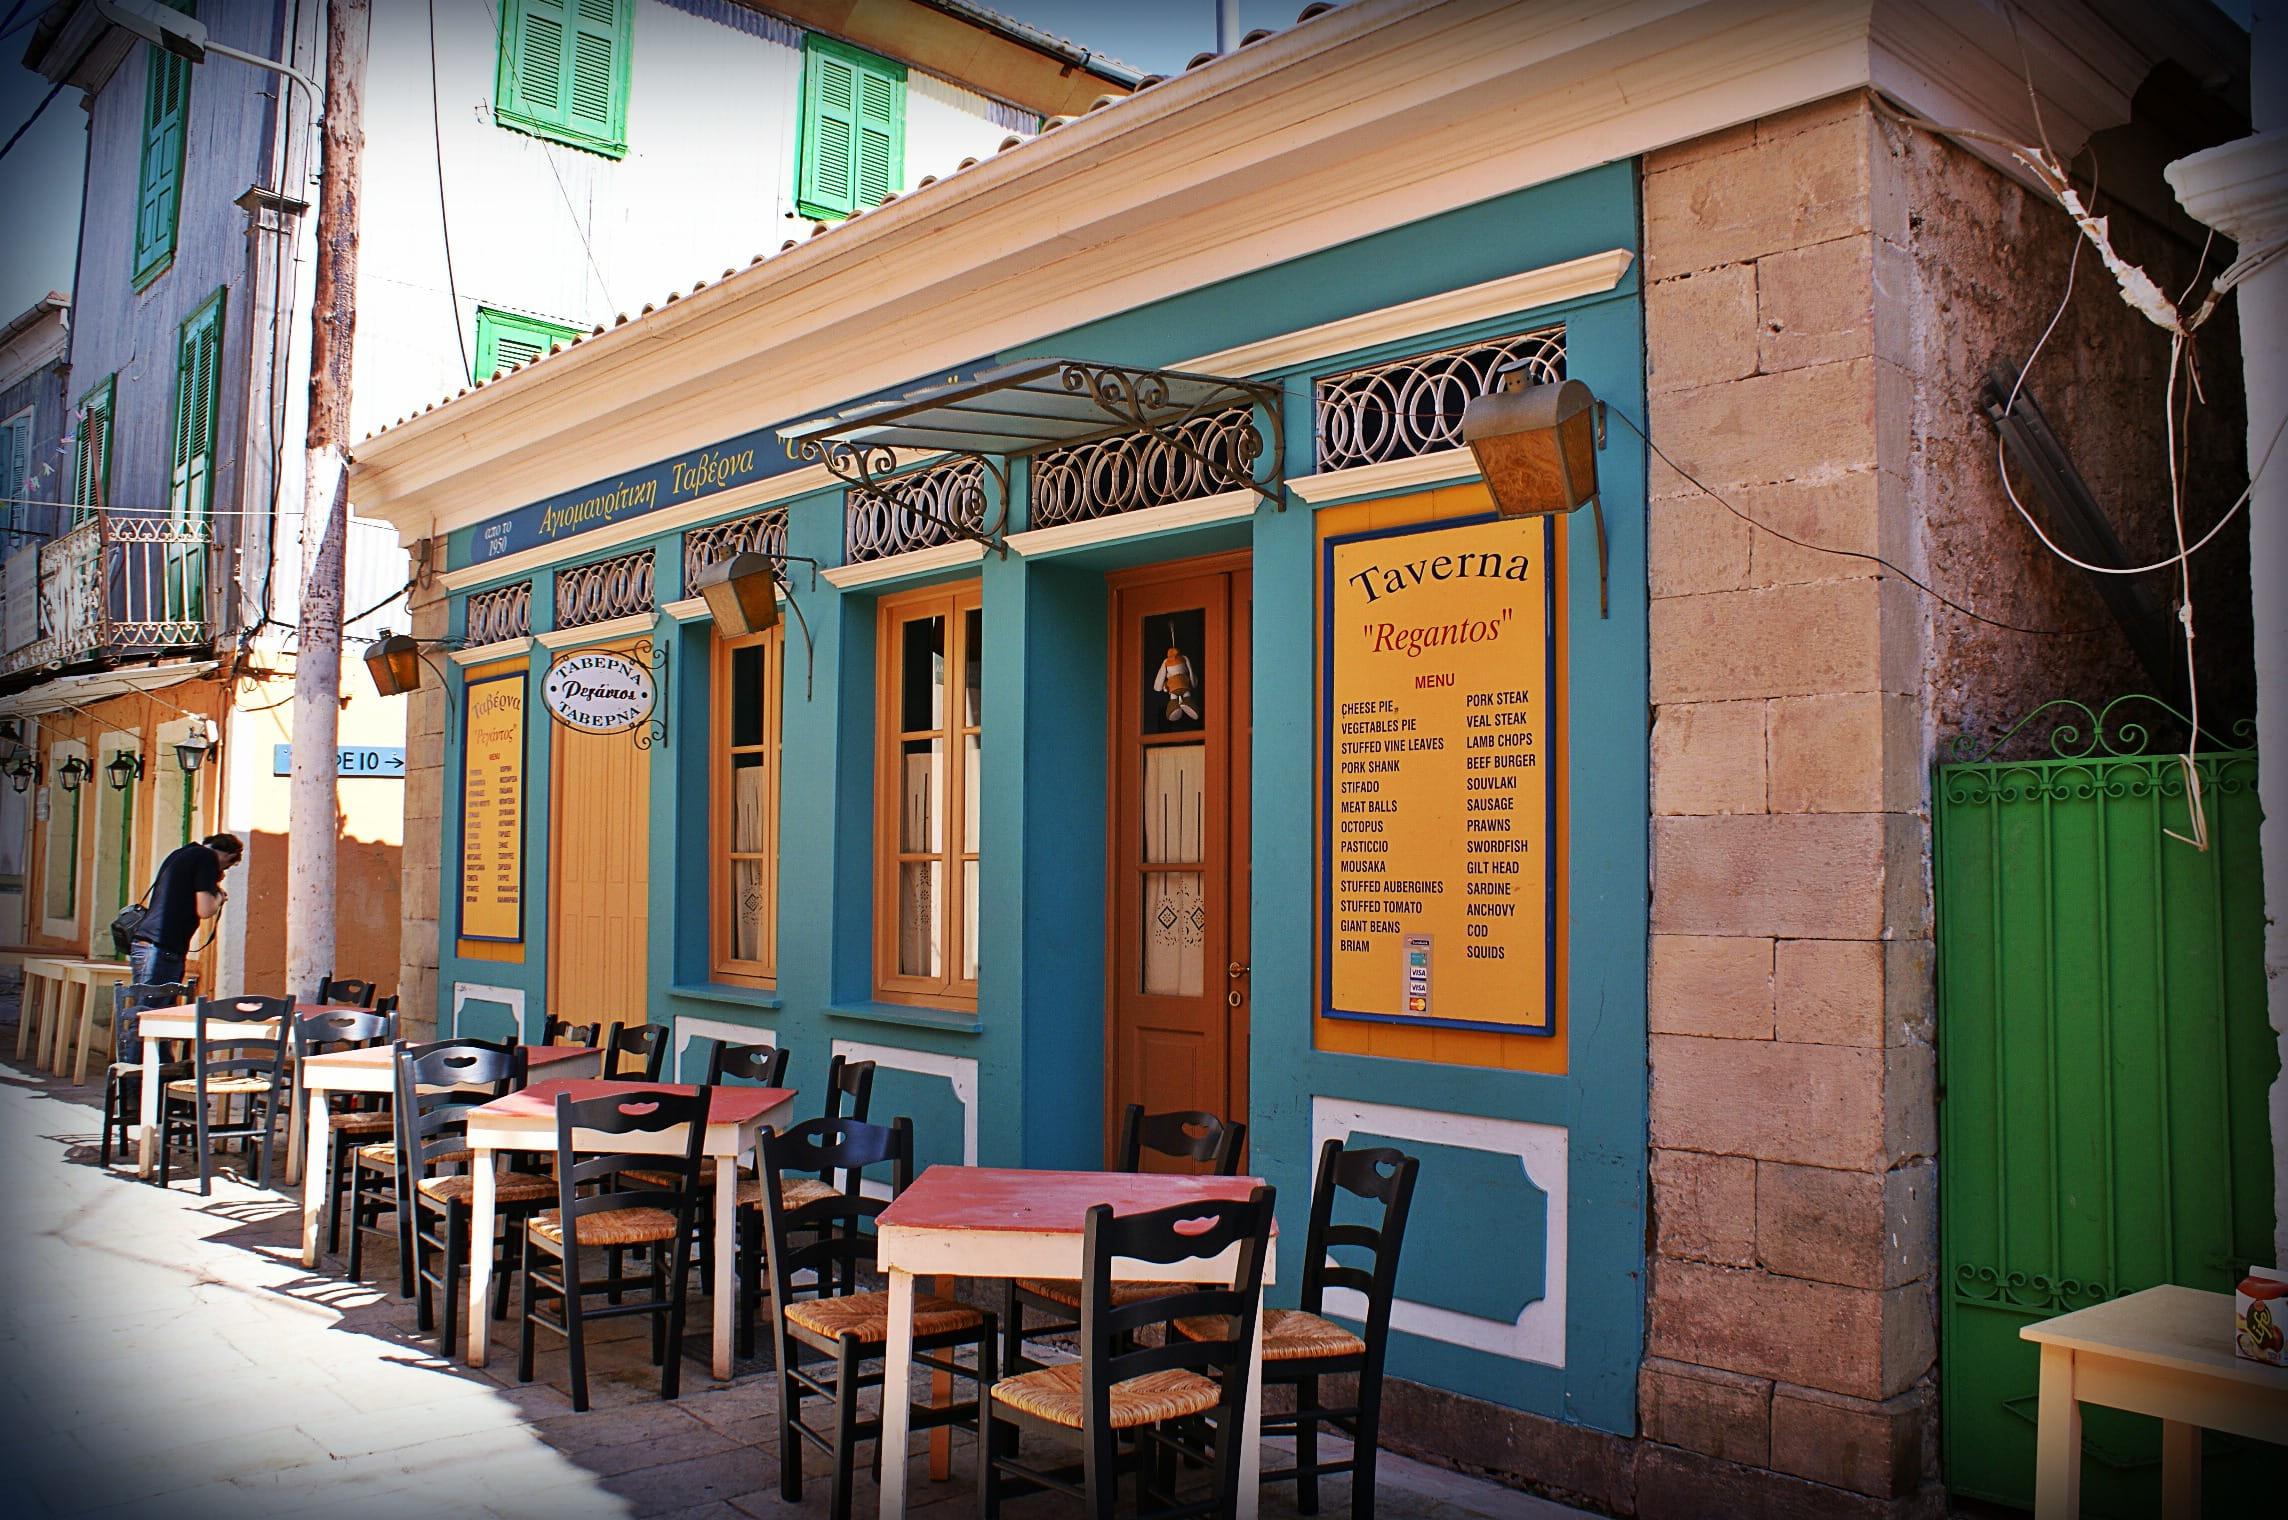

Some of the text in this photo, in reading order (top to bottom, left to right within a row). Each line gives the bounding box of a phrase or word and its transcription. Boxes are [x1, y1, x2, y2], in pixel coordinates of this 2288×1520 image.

[671, 447, 754, 497] Ταβέρνα
[489, 536, 507, 556] 1950
[1348, 550, 1529, 605] Taverna
[1363, 607, 1513, 658] "Regantos"
[556, 658, 641, 686] ΤΑΒΕΡΝΑ
[1415, 672, 1455, 689] MENU
[1467, 691, 1528, 707] PORK STEAK
[560, 701, 640, 726] ΤΑΒΕΡΝΑ
[1342, 702, 1376, 714] CHEESE
[1467, 712, 1526, 727] VEAL STEAK
[1342, 719, 1416, 734] VEGETABLES PIE
[1342, 738, 1443, 754] STUFFED VINE LEAVES
[1467, 733, 1532, 748] LAMB CHOPS
[1342, 760, 1399, 773] PORK SHANK
[1467, 754, 1535, 769] BEEF BURGER
[1342, 781, 1379, 793] STIFADO
[1467, 776, 1516, 790] SOUVLAKI
[1342, 800, 1397, 812] MEAT BALLS
[1467, 798, 1513, 811] SAUSAGE
[1342, 821, 1383, 832] OCTOPUS
[1468, 819, 1510, 832] PRAWNS
[1342, 841, 1388, 852] PASTICCIO
[1468, 840, 1527, 853] SWORDFISH
[1341, 861, 1385, 872] MOUSAKA
[1467, 862, 1519, 873] GILT HEAD
[1341, 880, 1443, 893] STUFFED AUBERGINES
[1467, 883, 1510, 895] SARDINE
[1341, 900, 1422, 913] STUFFED TOMATO
[1467, 904, 1515, 916] ANCHOVY
[1341, 920, 1400, 933] GIANT BEANS
[1468, 924, 1488, 937] COD
[1341, 940, 1369, 952] BRIAM
[1467, 946, 1504, 959] SQUIDS
[2243, 1308, 2273, 1343] Life
